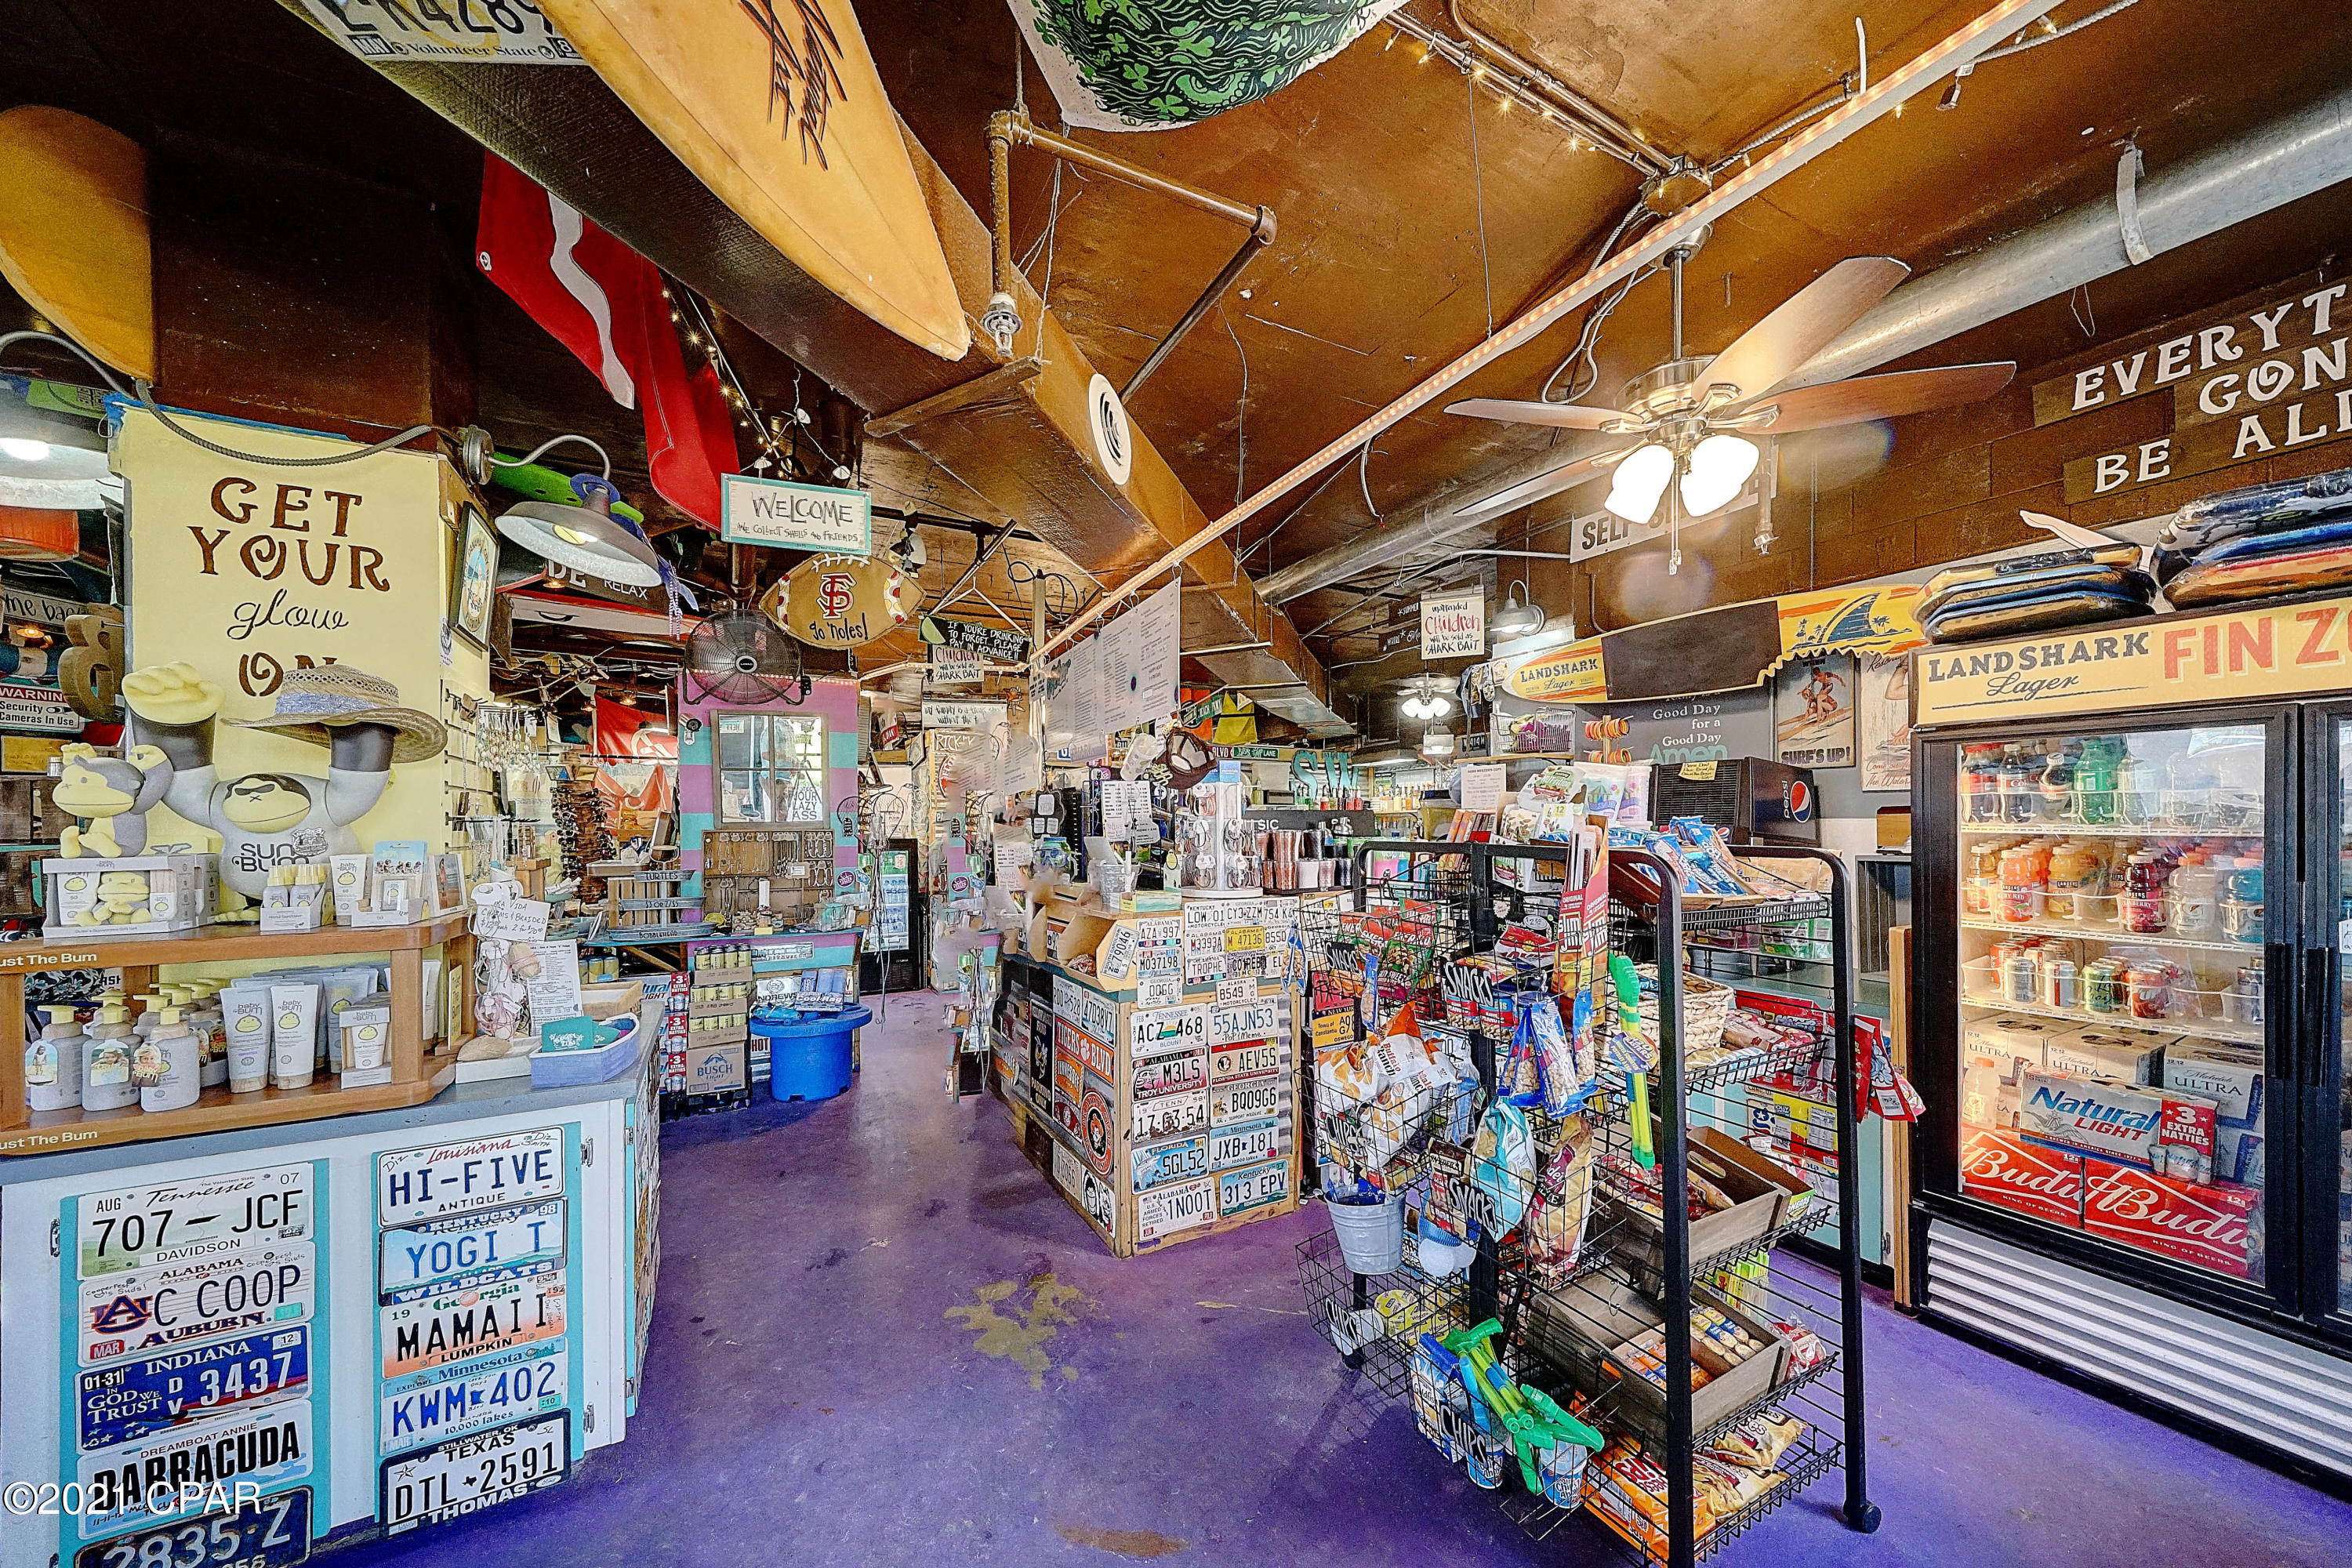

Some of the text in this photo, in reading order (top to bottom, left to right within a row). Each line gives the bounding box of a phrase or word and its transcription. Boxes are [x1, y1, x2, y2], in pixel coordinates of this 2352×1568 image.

[408, 43, 538, 56] Volunteer State
[2071, 284, 2347, 412] EVERYT
[2199, 337, 2349, 415] GON
[2094, 438, 2171, 494] BE
[211, 477, 362, 537] GET
[753, 492, 853, 527] WELCOME
[753, 524, 783, 537] COLLECT
[784, 528, 808, 539] SHELLS
[810, 532, 822, 541] AND
[823, 530, 858, 543] FRIENDS
[187, 525, 390, 592] YOUR
[604, 579, 648, 600] RELAX
[227, 588, 349, 641] glow
[948, 621, 1025, 644] IF YOU'RE DRINKING
[949, 630, 959, 638] TO
[994, 641, 1022, 652] PLEASE
[1450, 632, 1464, 641] sold
[1425, 639, 1480, 655] SHARK BAiT
[1929, 617, 2273, 682] LANDSHARK FIN
[936, 671, 962, 681] SHARK
[1520, 659, 1599, 683] LANDSHARK
[1987, 672, 2080, 701] Lager
[0, 701, 42, 714] Security
[1653, 704, 1721, 720] Good Day
[0, 712, 74, 726] Cameras In Use
[1692, 719, 1710, 729] for
[1662, 733, 1721, 746] Good Day
[1781, 746, 1850, 764] SURF'S UP!
[1782, 779, 1791, 818] pepsi
[793, 811, 817, 820] ASS
[645, 872, 678, 880] TURTLES
[1562, 894, 1584, 903] ORIGINAL
[1188, 912, 1206, 924] LOW
[1264, 907, 1279, 919] 754
[1141, 926, 1179, 940] AZA 997
[676, 975, 684, 984] 3
[1444, 961, 1494, 1007] SNACKS
[822, 995, 843, 1004] Rag
[1219, 986, 1243, 1000] 8549
[673, 1018, 681, 1026] 3
[1152, 1010, 1189, 1022] TENNESSEE
[1214, 1007, 1273, 1036] 55AJN53
[1057, 1018, 1112, 1079] TIGERS BLVD
[1160, 1039, 1182, 1047] BLOUNT
[1969, 1043, 2011, 1060] ULTRA
[673, 1055, 681, 1065] 3
[1149, 1052, 1183, 1065] ALABAMA
[2053, 1060, 2101, 1077] ULTRA
[697, 1064, 733, 1077] BUSCH
[1163, 1058, 1200, 1086] M3LS
[1212, 1075, 1233, 1083] FLORIDA
[1250, 1068, 1279, 1077] UNIVERSITY
[2183, 1069, 2234, 1083] Michelob
[1138, 1079, 1203, 1099] TROY UNIVERSITY
[1227, 1080, 1265, 1091] GEORGIA
[2175, 1076, 2243, 1096] ULTRA
[1160, 1098, 1182, 1108] TENN
[2029, 1086, 2162, 1131] Natural
[2176, 1105, 2196, 1124] 3
[1230, 1122, 1261, 1134] Minnesota
[2074, 1117, 2150, 1141] LIGHT
[2161, 1127, 2210, 1147] NATTIES
[2166, 1121, 2205, 1137] EXTRA
[426, 1139, 520, 1164] Louisiana
[1151, 1142, 1189, 1155] FLORIDA
[2048, 1135, 2071, 1144] BREWED
[2079, 1142, 2104, 1153] AMERICA
[280, 1172, 299, 1185] 07
[390, 1149, 554, 1207] HI-FIVE
[1238, 1167, 1272, 1181] Kentucky
[146, 1181, 256, 1207] Tennessee
[1157, 1185, 1189, 1200] ALABAMA
[1225, 1172, 1286, 1204] 313 EPV
[96, 1197, 122, 1213] AUG
[438, 1192, 506, 1212] ANTIQUE
[539, 1204, 557, 1215] 98
[2003, 1194, 2021, 1204] KING
[2038, 1205, 2066, 1217] BEERS
[93, 1190, 303, 1257] 707 JCF
[430, 1207, 523, 1230] KENTUCKY
[1142, 1218, 1163, 1227] RETIRED
[157, 1238, 241, 1262] DAVIDSON
[405, 1221, 546, 1278] YOGI T
[2153, 1240, 2176, 1251] KING
[2197, 1252, 2231, 1265] BEERS
[159, 1258, 245, 1280] ALABAMA
[396, 1261, 554, 1302] WILDCATS
[392, 1309, 411, 1320] 19
[136, 1312, 266, 1350] AUBURN
[93, 1342, 121, 1359] MAR
[145, 1341, 252, 1376] INDIANA
[441, 1337, 514, 1363] LUMPKIN
[438, 1351, 522, 1381] Minnesota
[199, 1351, 292, 1407] 3437
[393, 1362, 557, 1438] KWM 402
[87, 1396, 162, 1425] TRUST
[140, 1422, 258, 1458] DREAMBOAT ANNIE
[1439, 1403, 1486, 1468] CHIPS
[444, 1434, 515, 1463] TEXAS
[93, 1421, 300, 1512] BARRACUDA
[395, 1441, 558, 1521] DTL 2591
[428, 1483, 528, 1523] THOMAS
